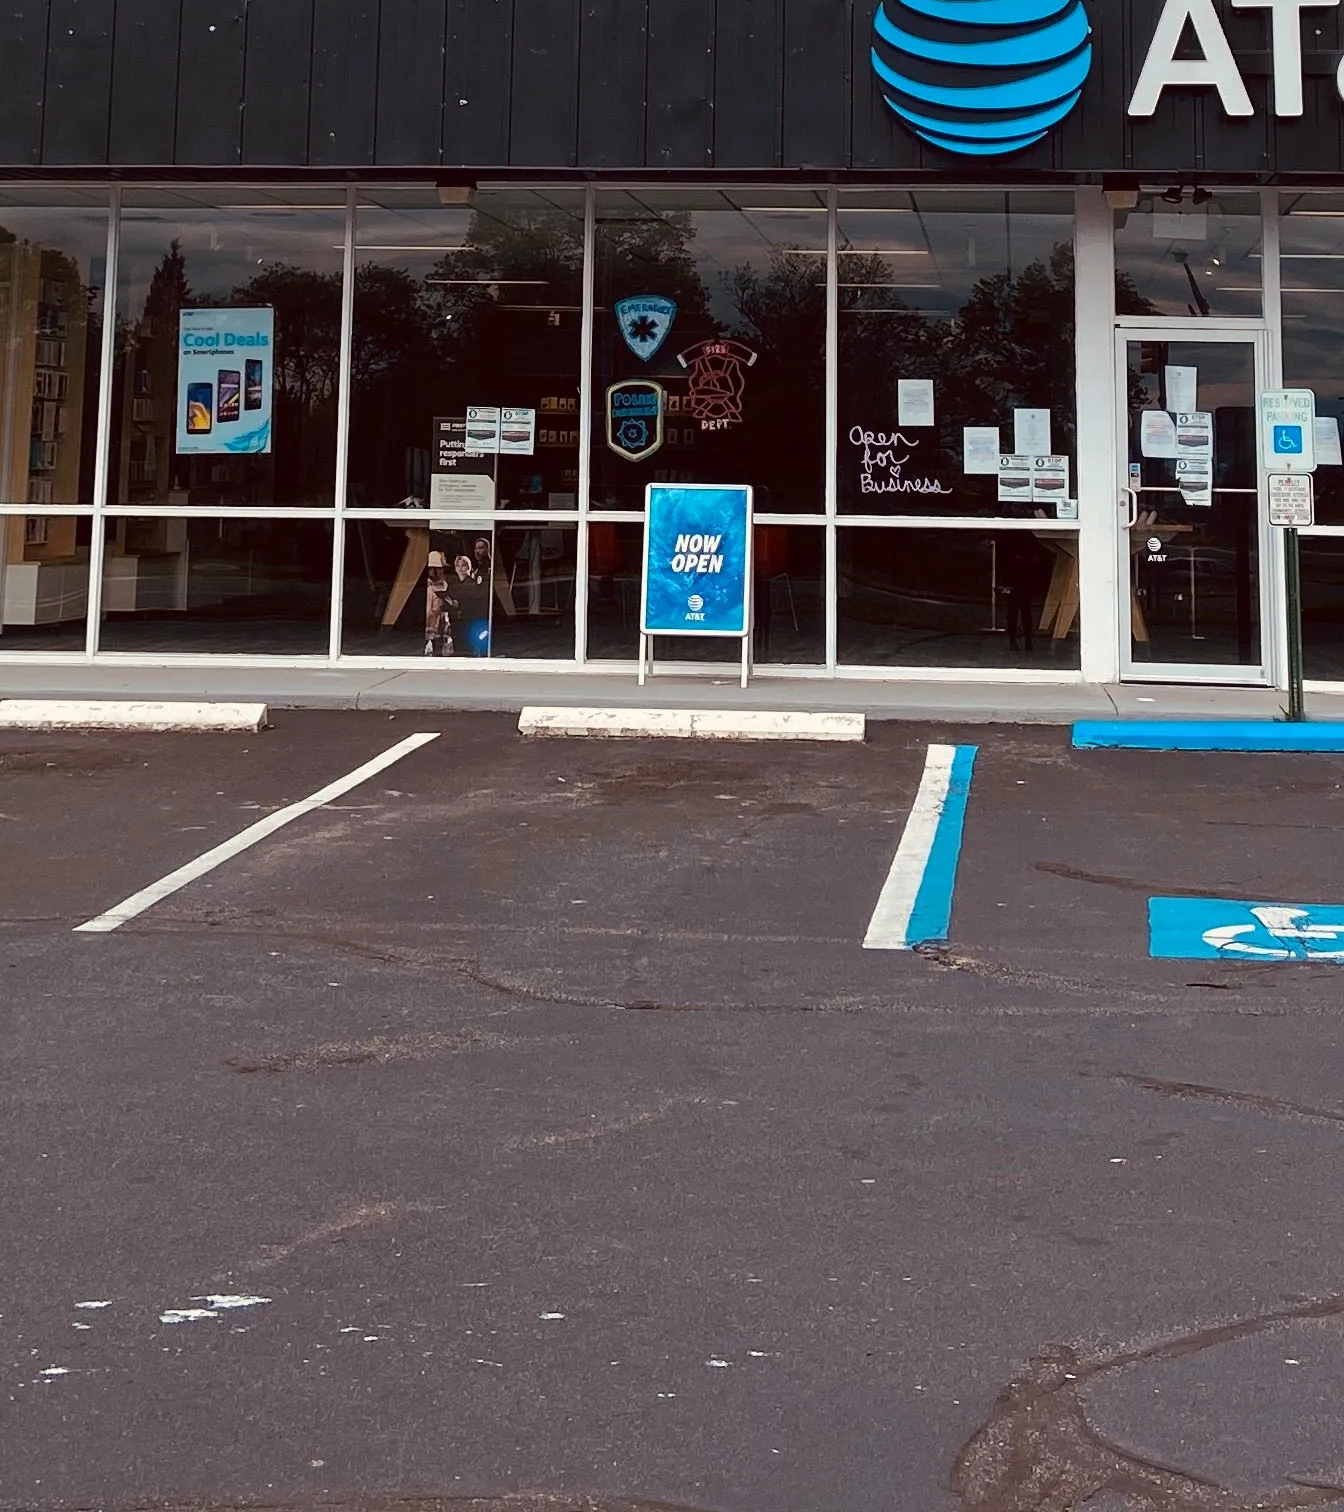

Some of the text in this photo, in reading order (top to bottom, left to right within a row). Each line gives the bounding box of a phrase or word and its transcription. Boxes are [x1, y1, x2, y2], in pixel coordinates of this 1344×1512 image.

[183, 332, 269, 347] Cool Deals
[1263, 397, 1310, 408] RESVED
[439, 439, 466, 449] Puttin
[849, 425, 920, 448] Open
[439, 458, 457, 466] first
[861, 447, 910, 474] for
[860, 473, 953, 494] Business
[674, 534, 722, 553] NOW
[671, 554, 724, 573] OPEN
[1147, 554, 1167, 562] AT&T
[684, 612, 706, 621] AT&T
